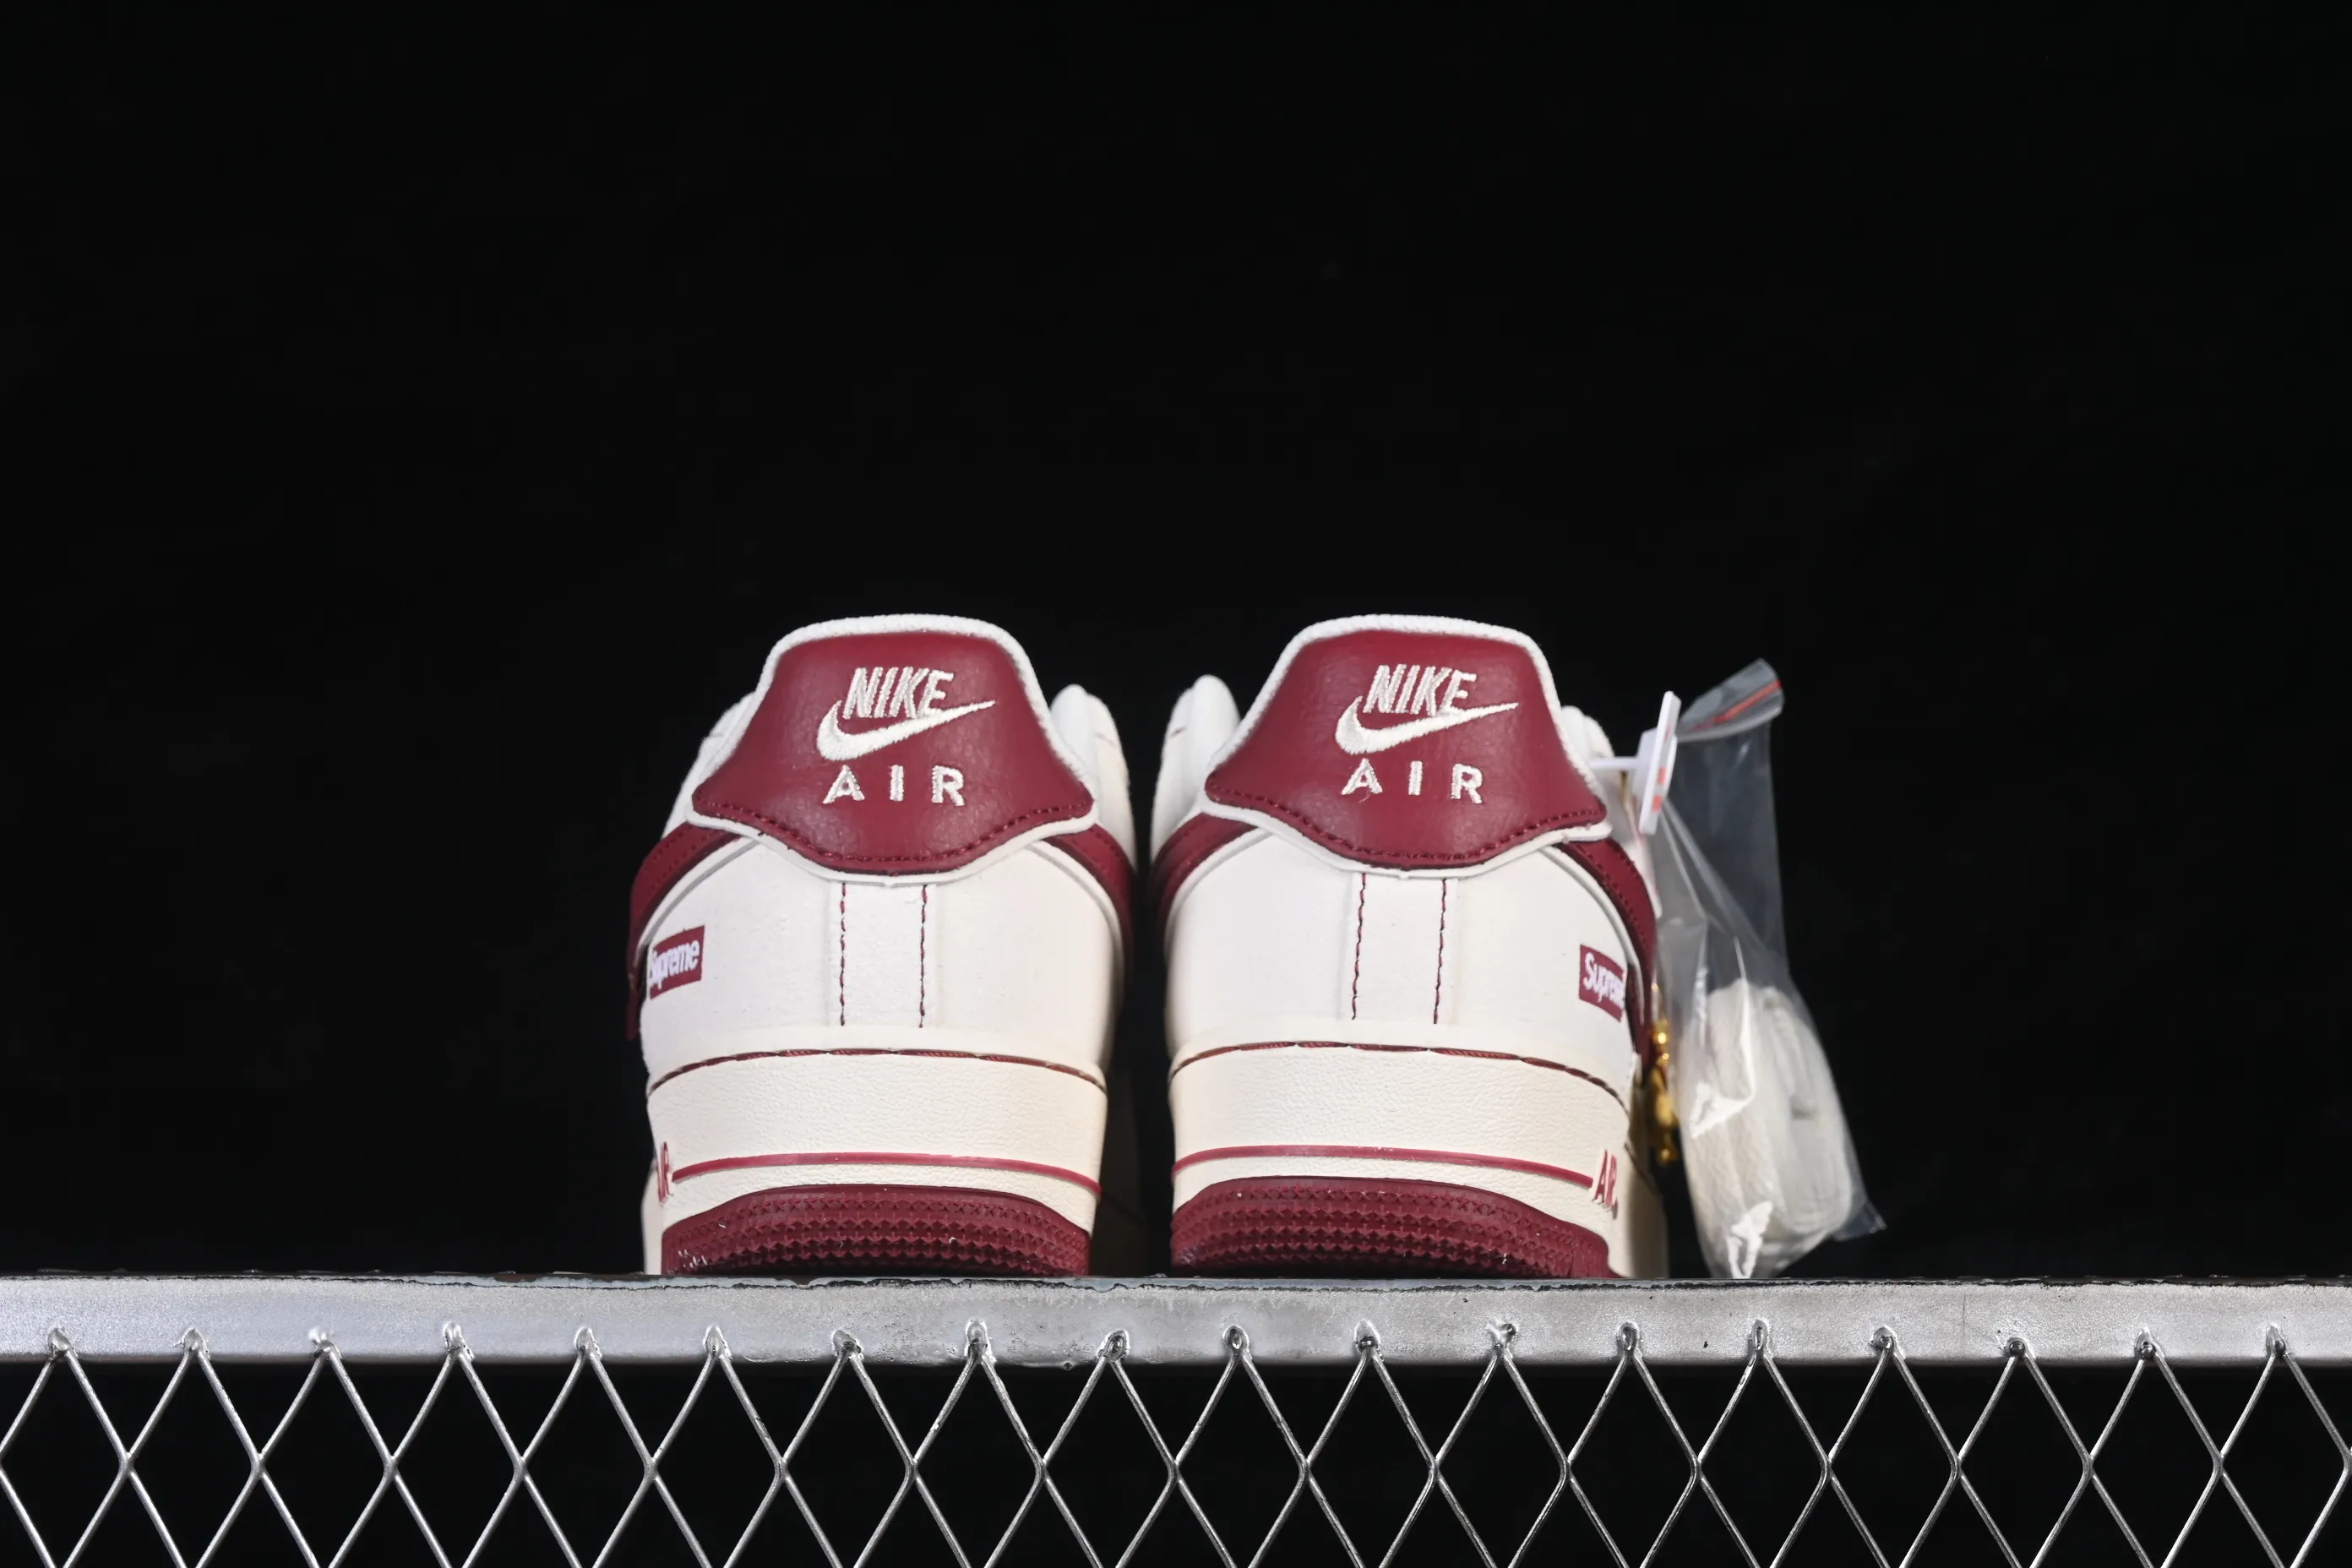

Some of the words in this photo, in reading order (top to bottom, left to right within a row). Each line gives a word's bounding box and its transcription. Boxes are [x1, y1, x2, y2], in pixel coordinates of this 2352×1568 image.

[842, 666, 955, 719] NIKE
[1362, 663, 1477, 716] NIKE
[822, 764, 965, 807] AIR
[1341, 758, 1484, 804] AIR
